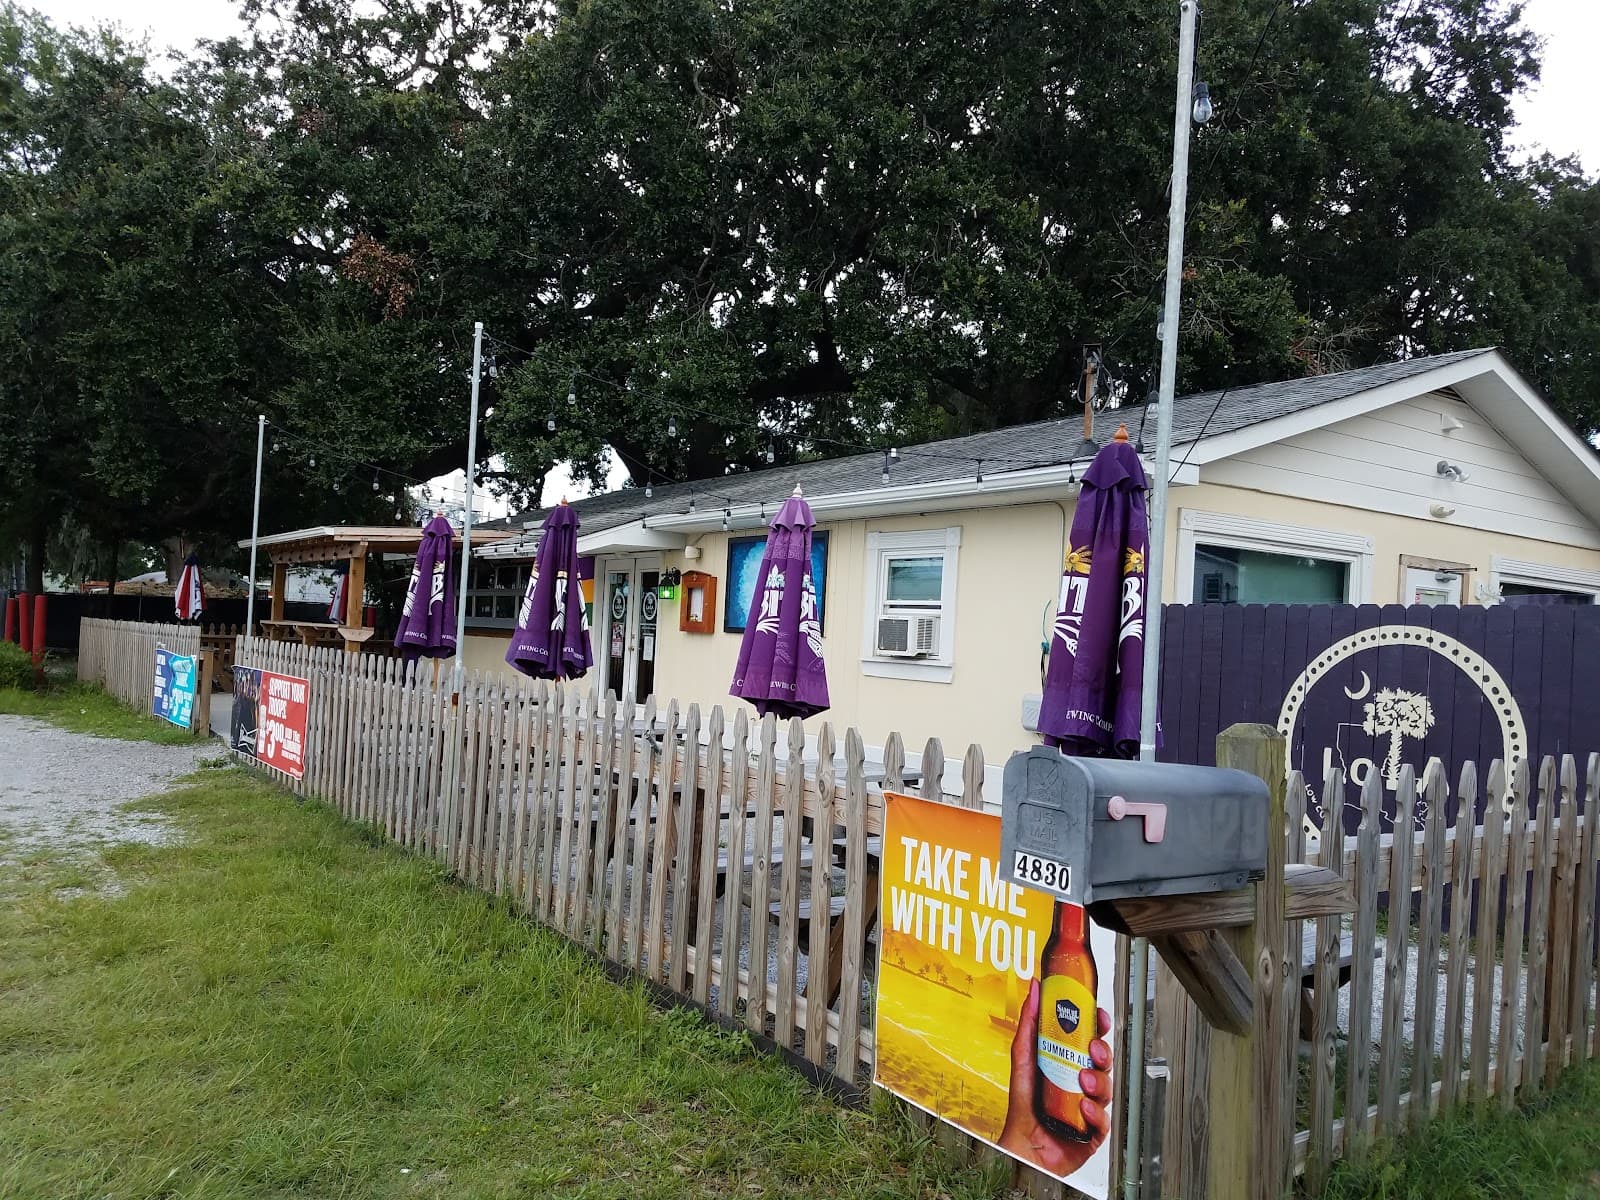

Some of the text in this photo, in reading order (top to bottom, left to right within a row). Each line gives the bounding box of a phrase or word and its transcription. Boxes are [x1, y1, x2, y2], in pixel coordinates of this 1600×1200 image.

[268, 677, 291, 700] SUPPORT
[900, 836, 1027, 919] TAKE ME
[1016, 854, 1070, 891] 4830
[891, 885, 1036, 980] WITH YOU
[1042, 1040, 1075, 1062] SUMMER
